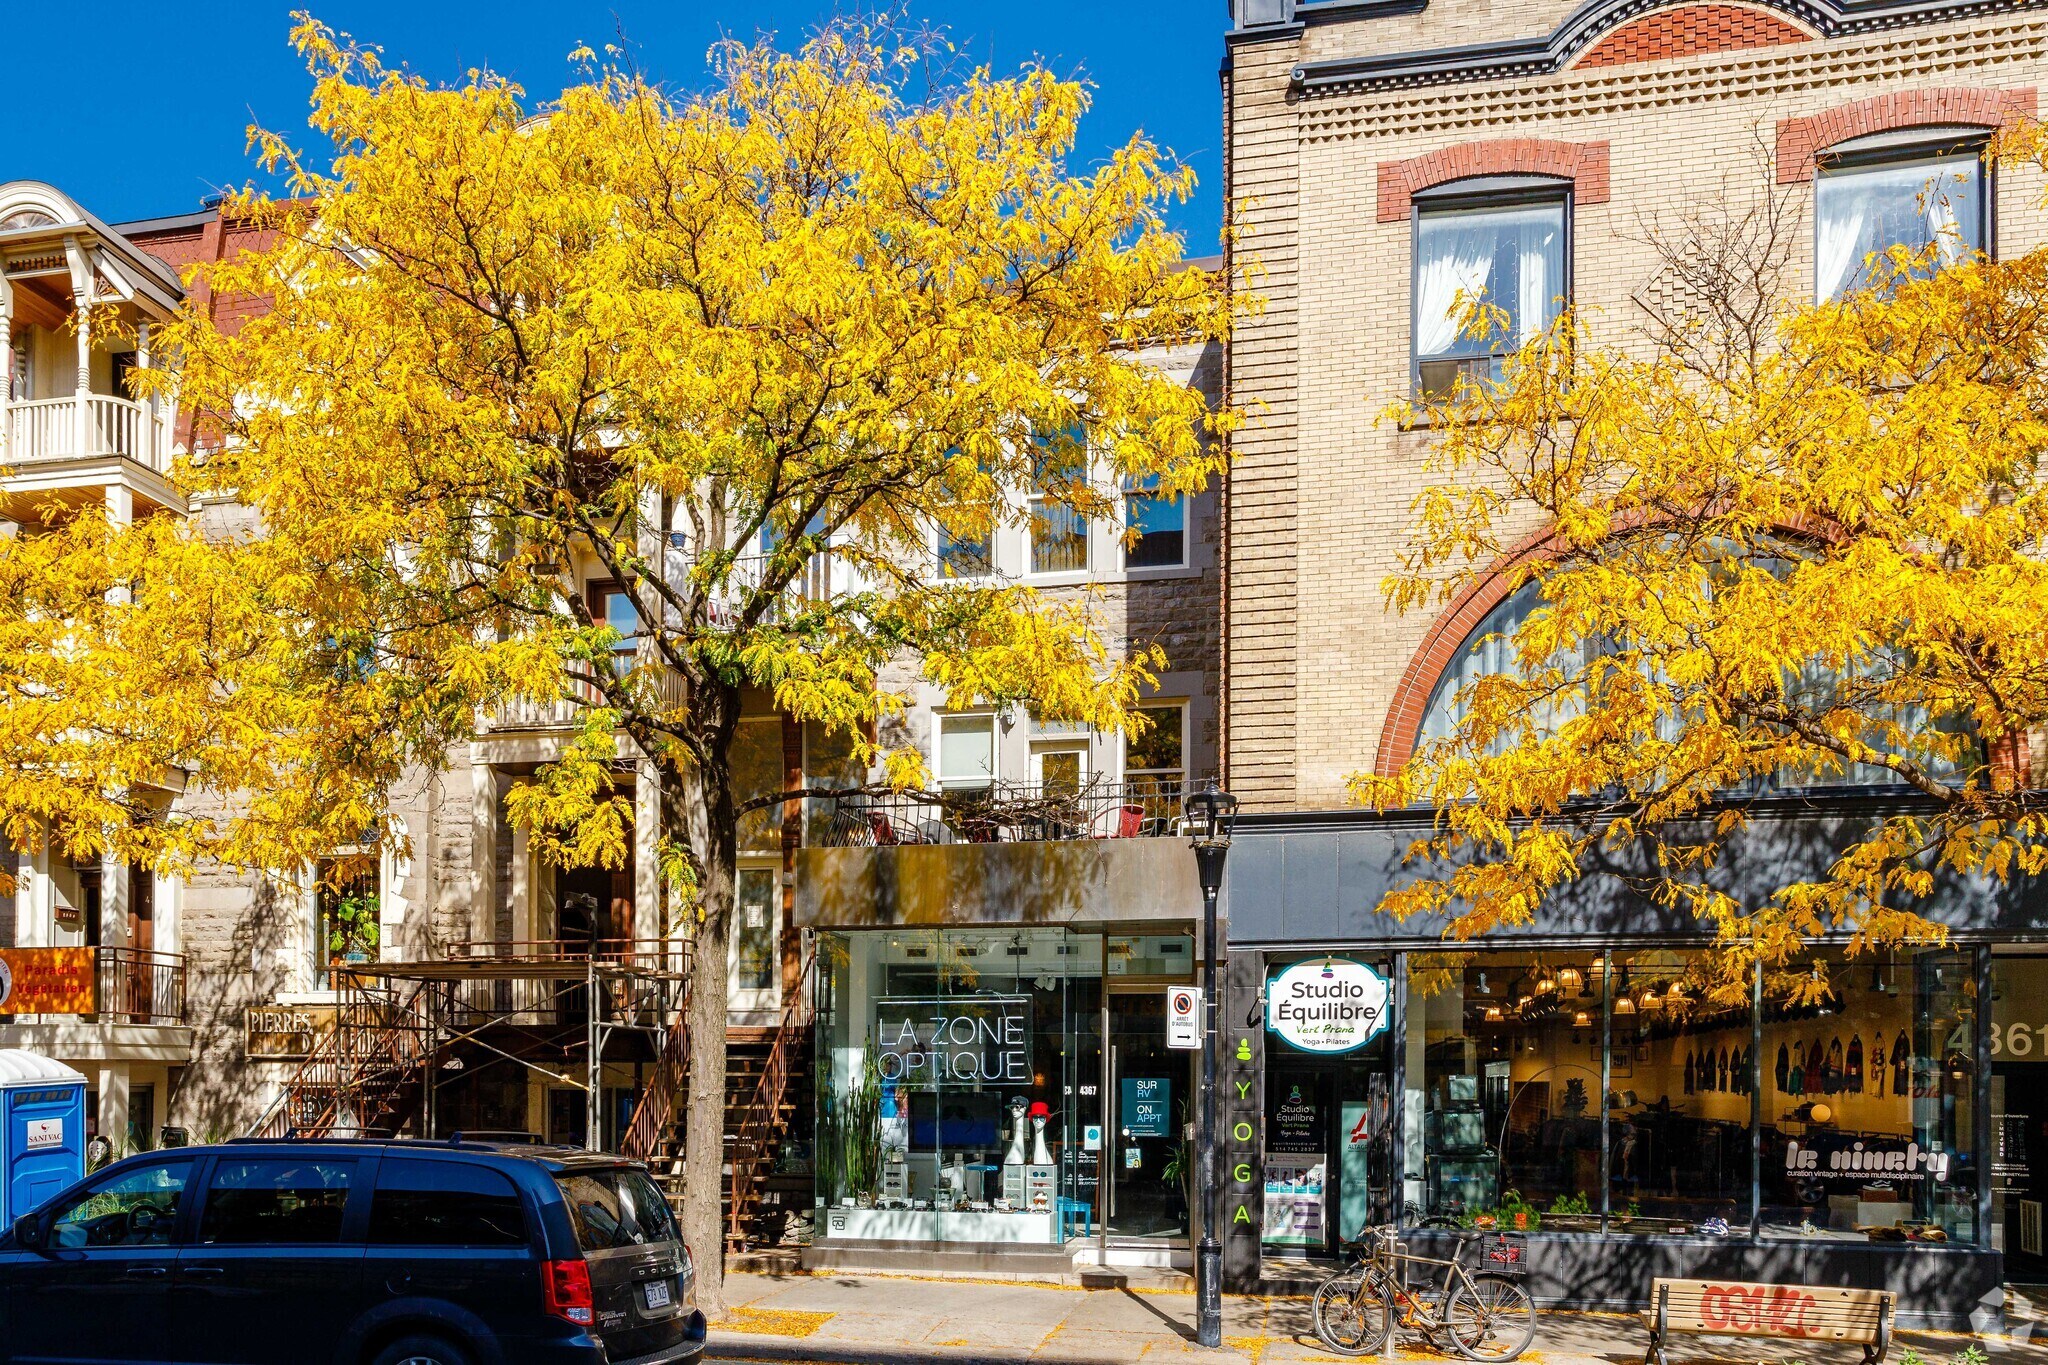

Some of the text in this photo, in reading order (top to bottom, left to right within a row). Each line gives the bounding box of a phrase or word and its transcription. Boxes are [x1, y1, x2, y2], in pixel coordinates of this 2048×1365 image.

[25, 964, 78, 976] Paradis
[16, 981, 86, 996] Végétarien
[1291, 980, 1364, 998] Studio
[1278, 1000, 1376, 1026] Équilibre
[250, 1012, 310, 1033] PIERRES
[879, 1016, 1025, 1045] LA ZONE
[1296, 1024, 1355, 1034] Vert Prana
[1302, 1038, 1320, 1046] Yoga
[878, 1051, 1026, 1080] OPTIQUE
[1079, 1085, 1097, 1096] 4367
[1136, 1080, 1158, 1090] SUR
[1136, 1089, 1151, 1098] RV
[1136, 1105, 1153, 1114] ON
[1280, 1105, 1310, 1113] Studio
[1136, 1114, 1162, 1123] APPT
[1276, 1112, 1315, 1123] Équilibre
[1233, 1081, 1253, 1224] YOGA
[1785, 1141, 1949, 1182] le ninety
[1814, 1170, 1838, 1179] vintage
[1845, 1171, 1870, 1180] espace
[1870, 1171, 1925, 1181] multidisciplinaire
